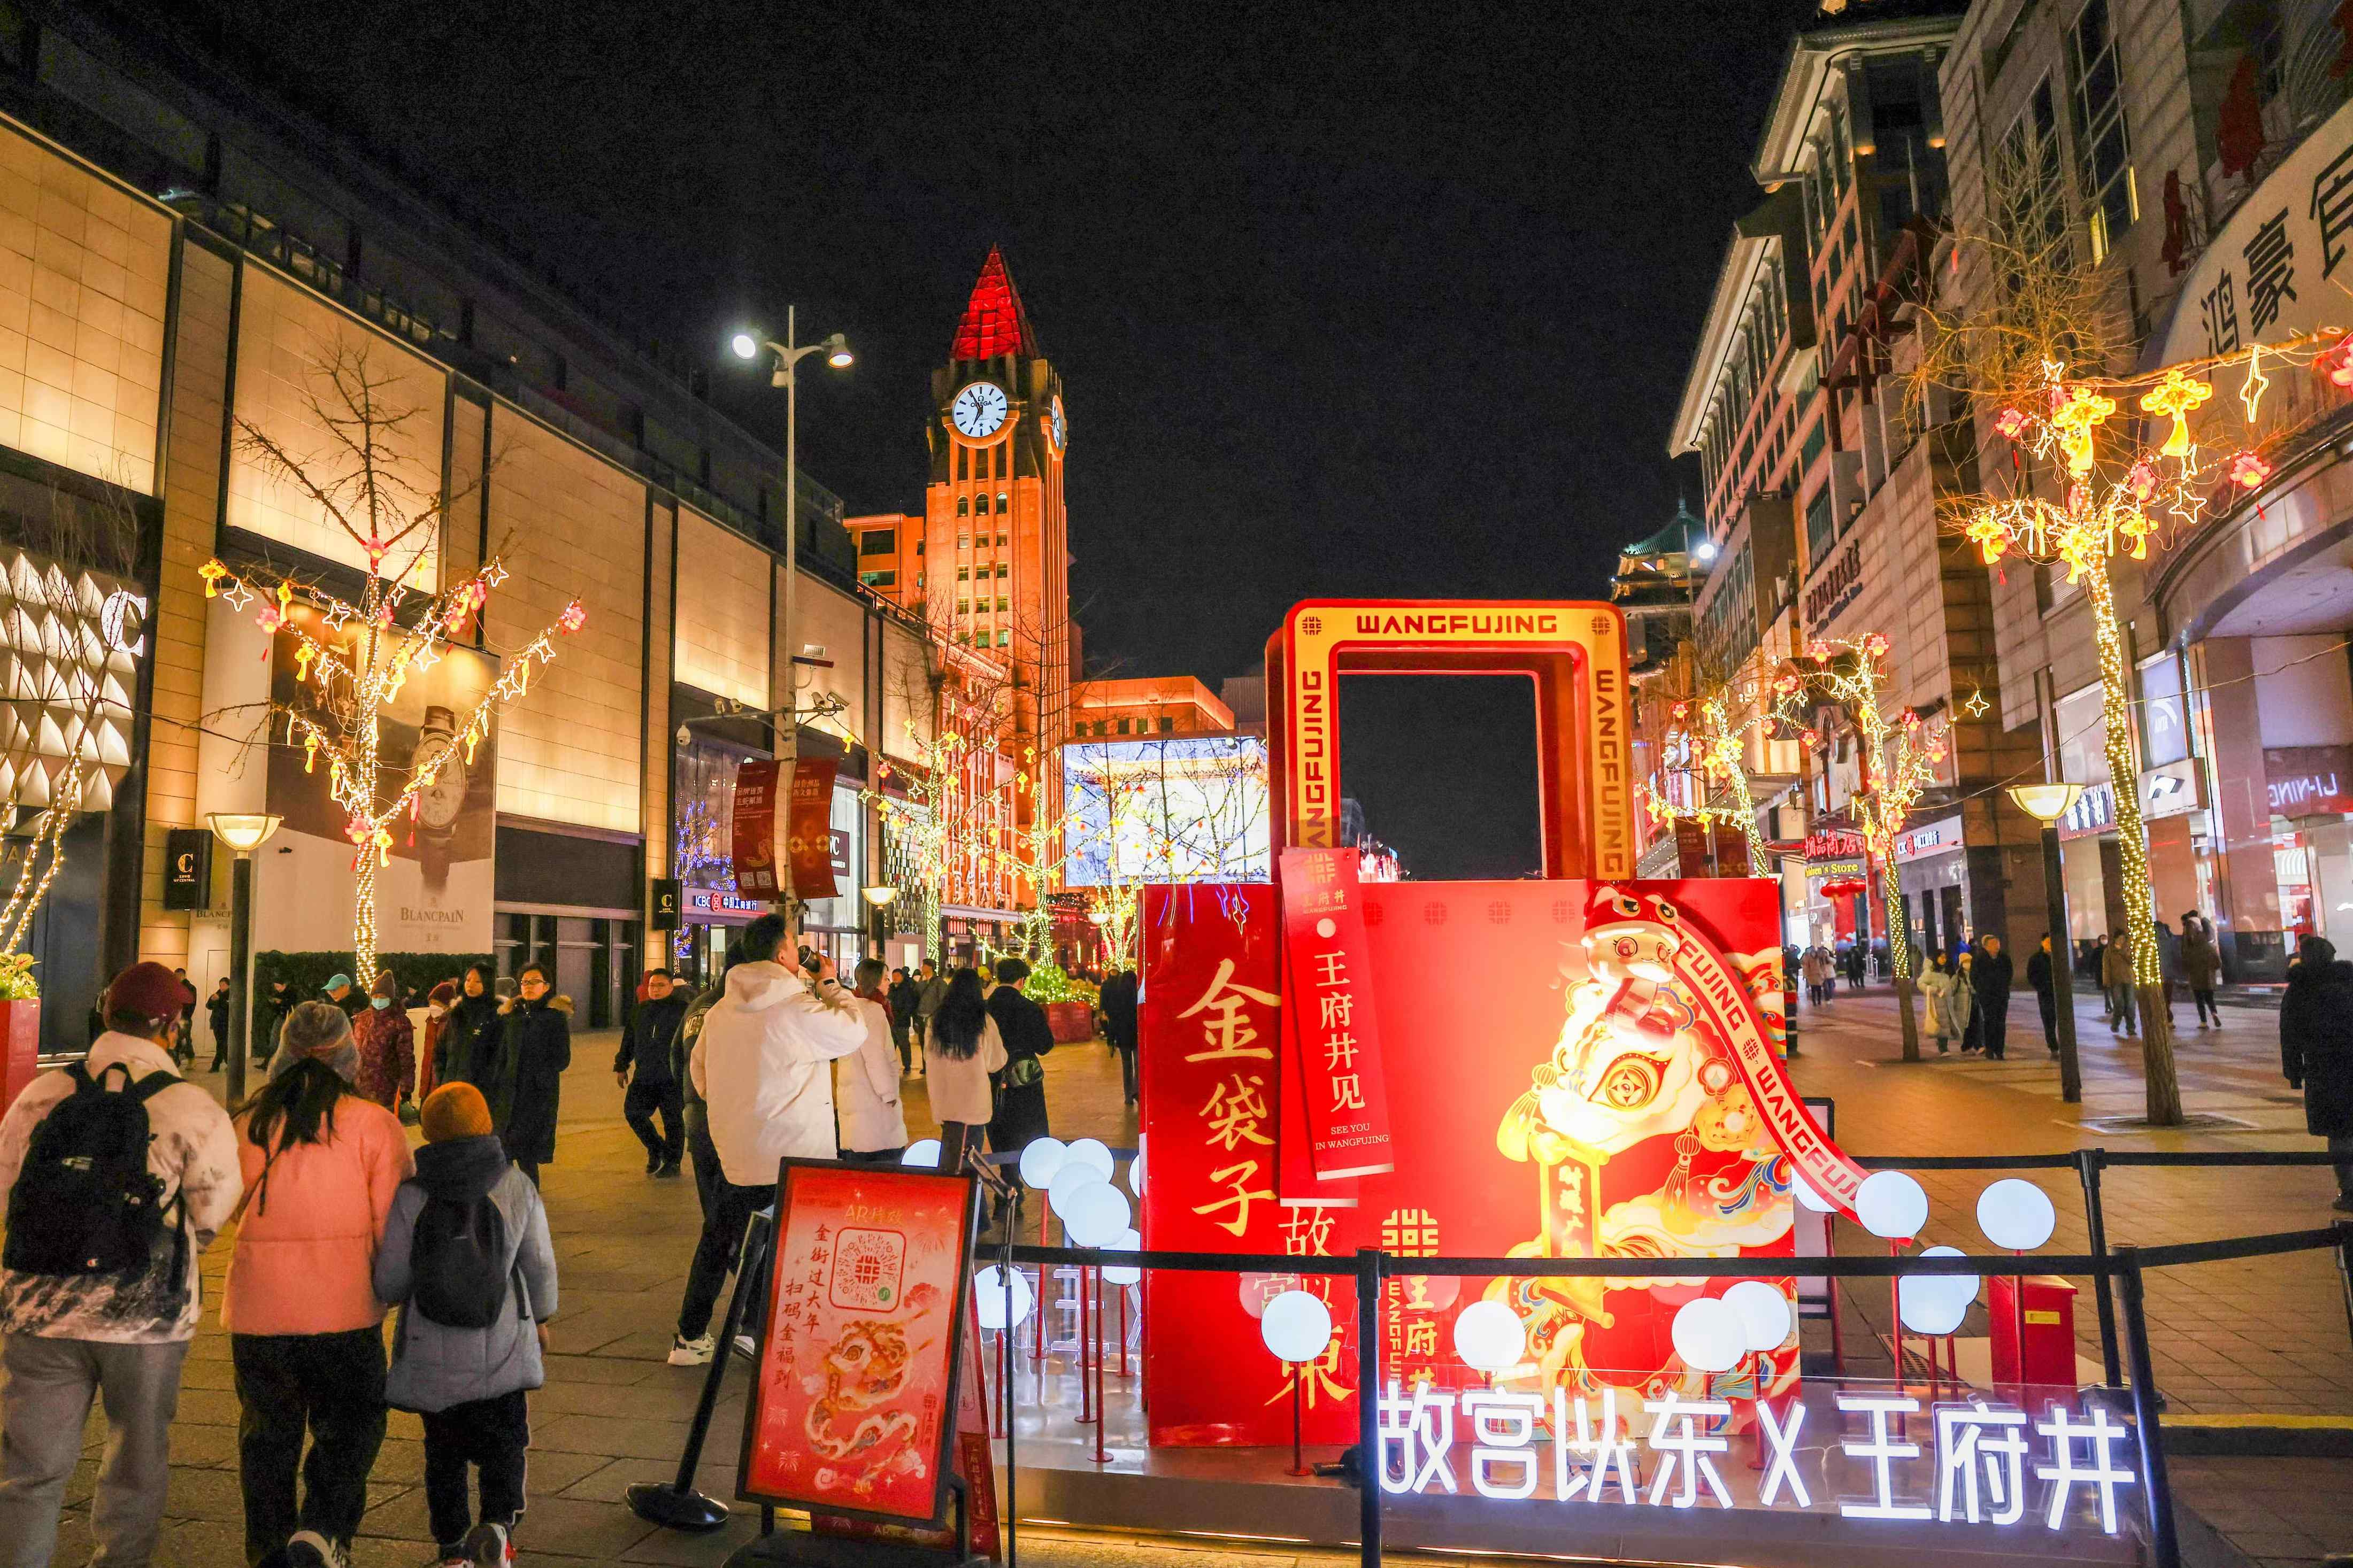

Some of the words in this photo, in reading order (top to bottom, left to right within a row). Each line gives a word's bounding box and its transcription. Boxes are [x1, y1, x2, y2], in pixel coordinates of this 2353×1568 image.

[1356, 615, 1557, 635] WANGFUJING
[1302, 671, 1327, 847] ANGFUJING
[1595, 669, 1624, 874] WANGFUJING
[401, 907, 464, 923] BLANCPAIN
[695, 895, 711, 908] ICBC
[1831, 863, 1859, 874] Store
[1313, 949, 1366, 1113] 王府井见
[1677, 940, 1746, 1031] FUJING
[1176, 957, 1281, 1237] 金袋子
[1315, 1141, 1326, 1150] IN
[1327, 1133, 1389, 1149] WANGFUJING
[1330, 1125, 1348, 1136] SEE
[1349, 1122, 1371, 1133] YOU
[802, 1223, 831, 1335] 金街过大年
[774, 1278, 804, 1390] 扫码金福到
[1388, 1281, 1402, 1378] WANGFUJI
